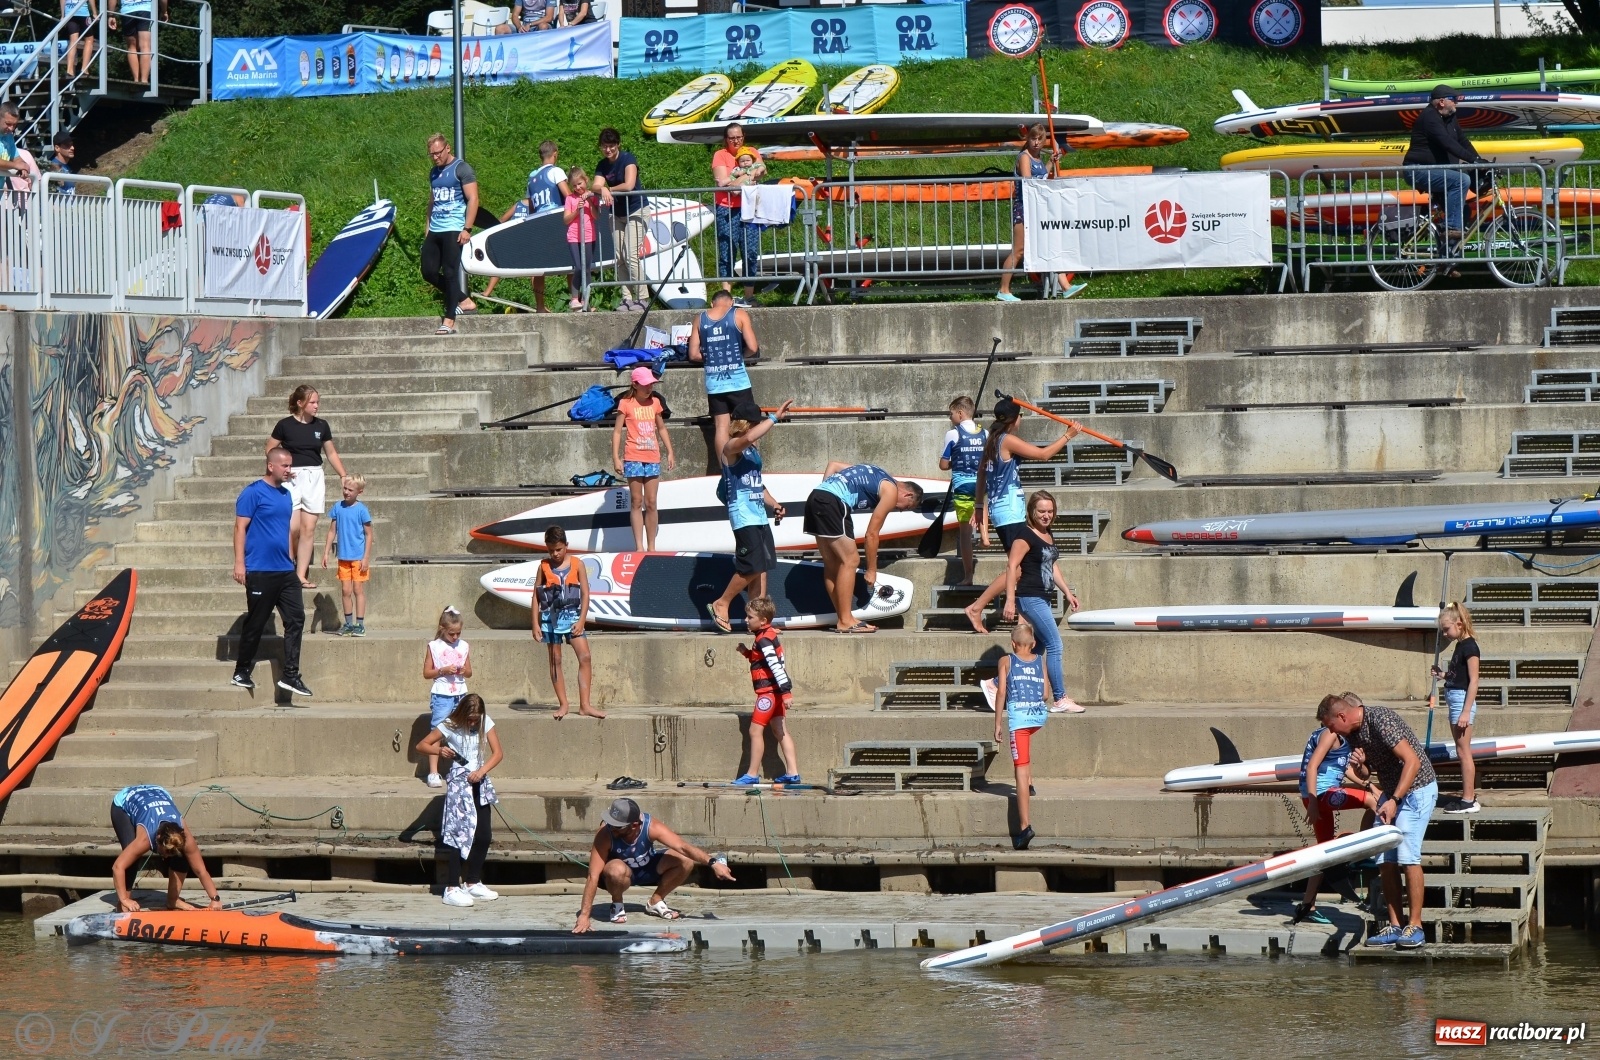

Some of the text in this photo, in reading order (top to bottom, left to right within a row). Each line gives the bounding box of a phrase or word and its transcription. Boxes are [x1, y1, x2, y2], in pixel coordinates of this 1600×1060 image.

[226, 71, 278, 82] Aqua Marina
[1461, 78, 1491, 87] BREEZE
[1191, 211, 1247, 220] Związek Sportowy
[1040, 214, 1130, 232] www.zwsup.pl
[1191, 220, 1221, 232] SUP
[272, 254, 286, 265] SUP
[712, 326, 723, 336] 81
[633, 406, 655, 421] HELLO
[1171, 531, 1238, 540] STARBOARD
[492, 576, 526, 584] GLADIATOR
[1022, 667, 1036, 675] 103
[1086, 913, 1116, 928] GLADIATOR
[182, 927, 269, 948] FEVER
